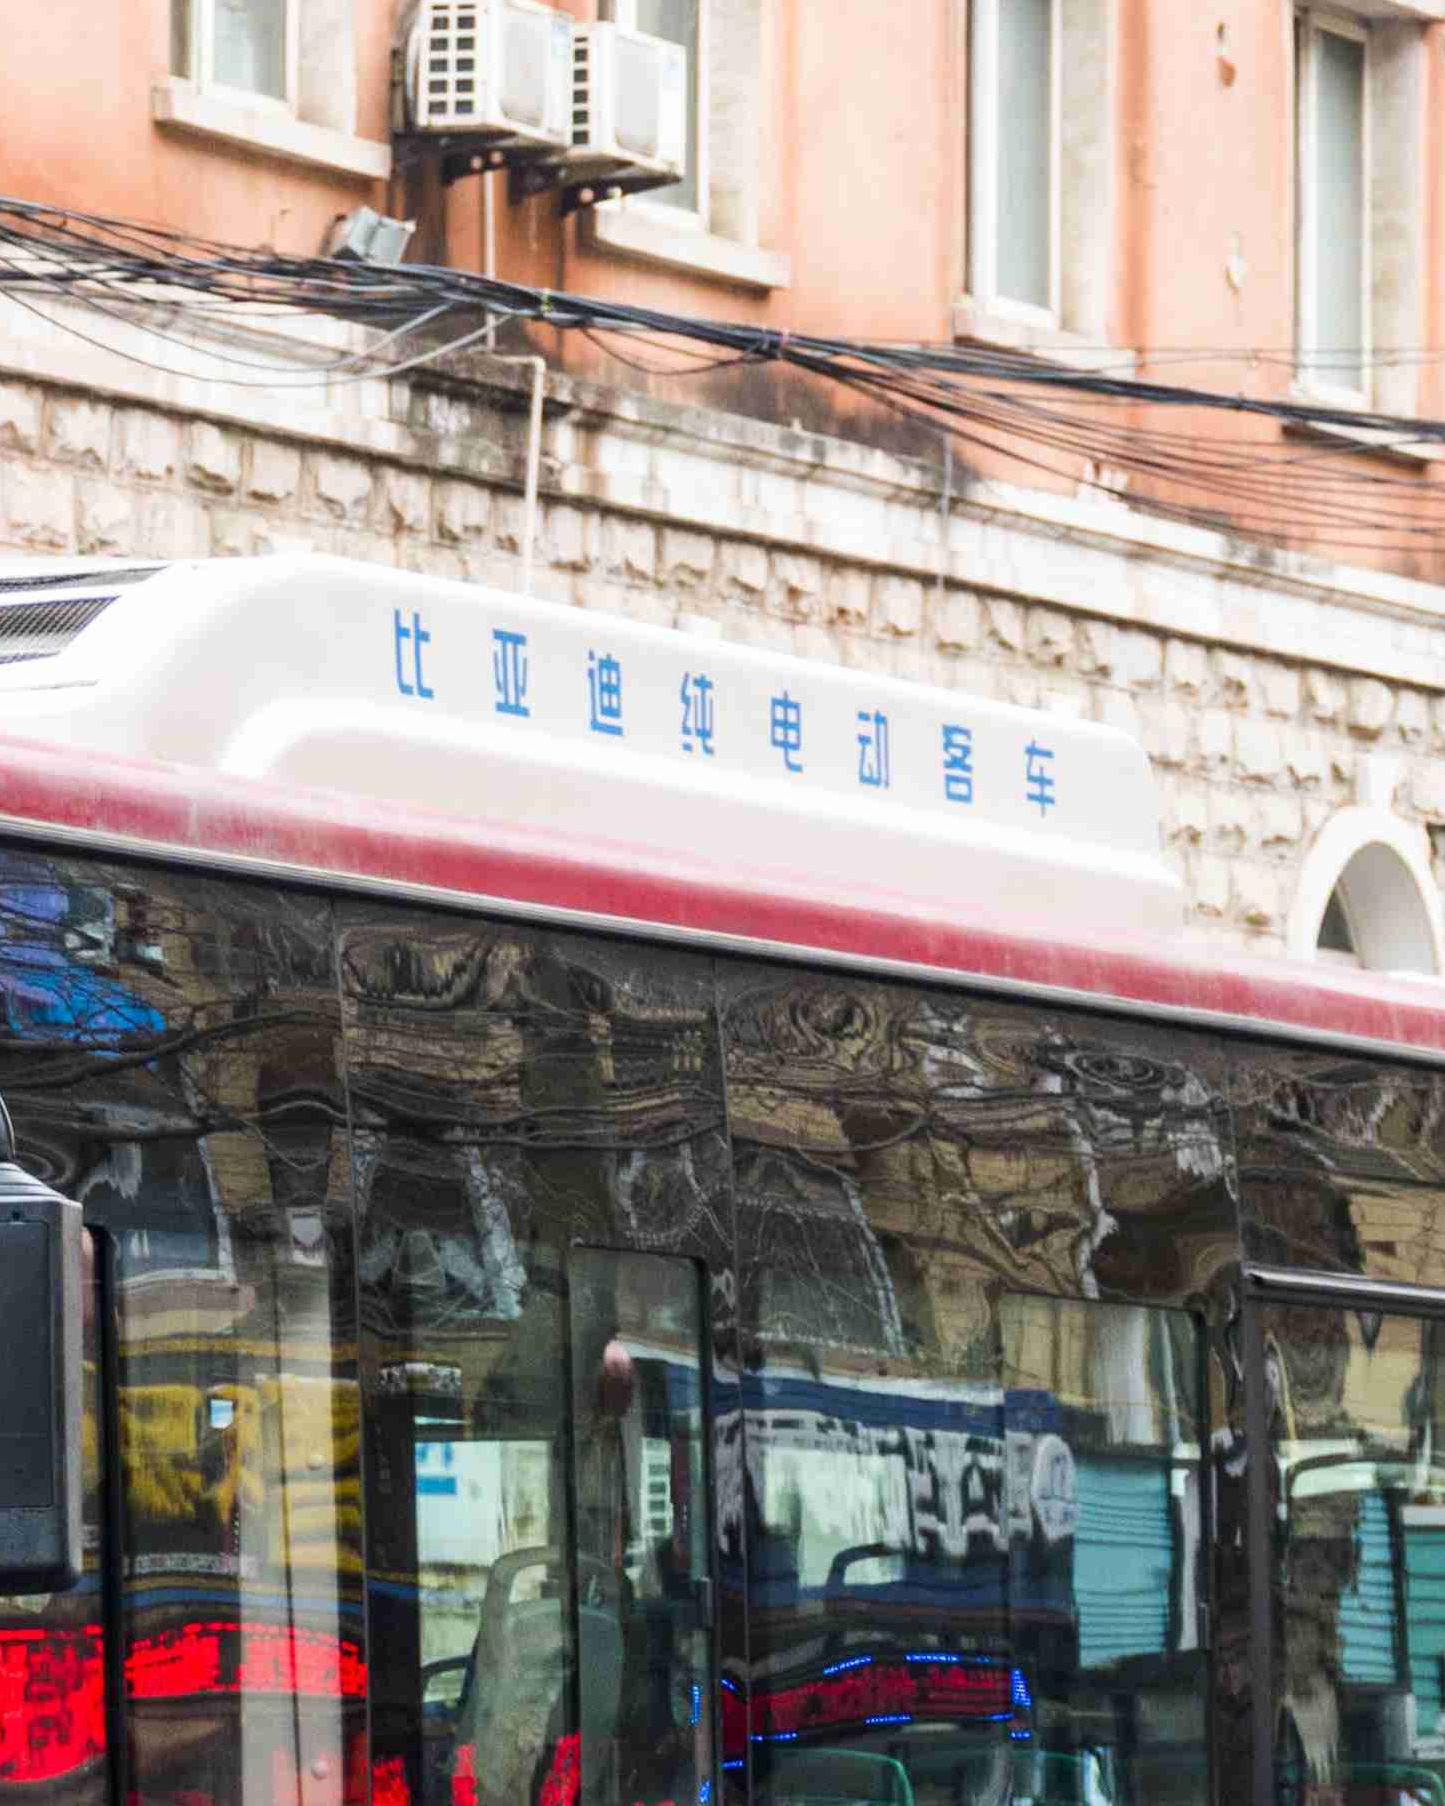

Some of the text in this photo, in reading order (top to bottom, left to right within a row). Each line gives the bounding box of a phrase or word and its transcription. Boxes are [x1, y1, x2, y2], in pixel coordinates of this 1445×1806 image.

[394, 608, 1057, 816] 比亚迪纯电动客车
